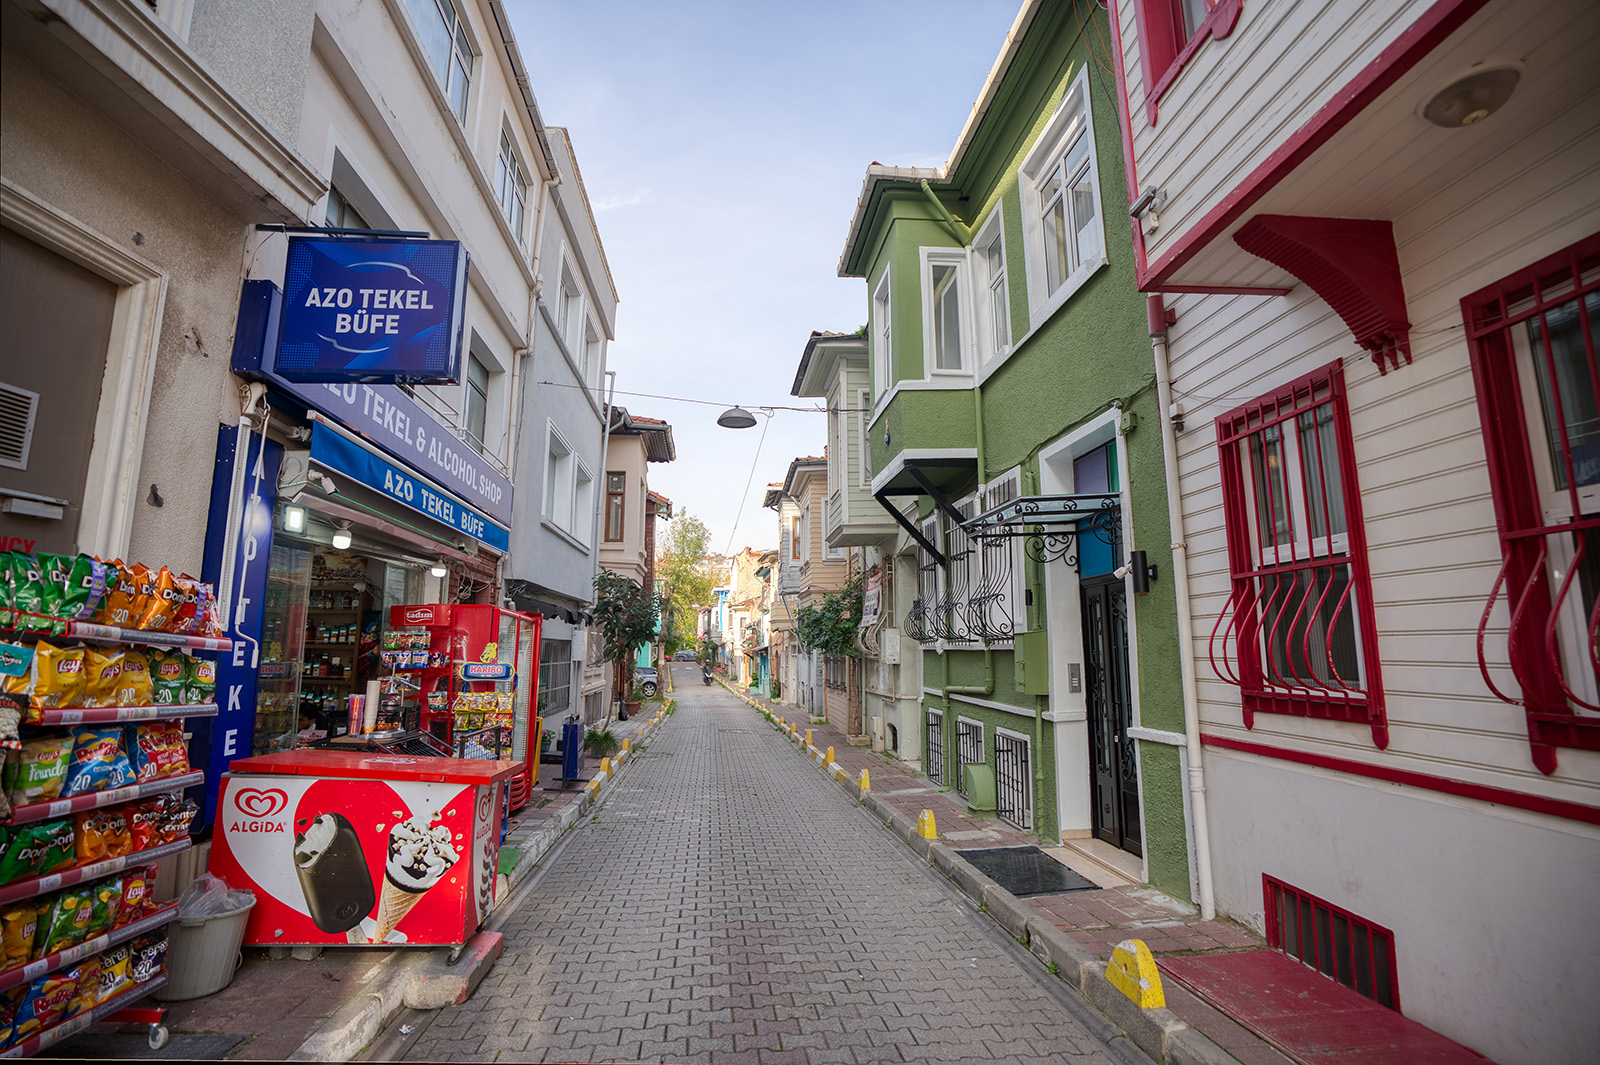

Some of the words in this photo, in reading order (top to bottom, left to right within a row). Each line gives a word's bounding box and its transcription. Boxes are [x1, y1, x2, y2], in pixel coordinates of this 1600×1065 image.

[305, 287, 353, 309] AZO
[359, 288, 434, 310] TEKEL
[335, 309, 400, 335] BÜFE
[362, 384, 413, 447] TEKEL
[416, 426, 426, 453] &
[428, 436, 478, 491] ALCOHOL
[479, 474, 502, 505] SHOP
[383, 469, 414, 502] AZO
[421, 488, 455, 524] TEKEL
[461, 512, 485, 538] BÜFE
[160, 662, 179, 675] Lay's
[470, 665, 503, 674] HARIBO
